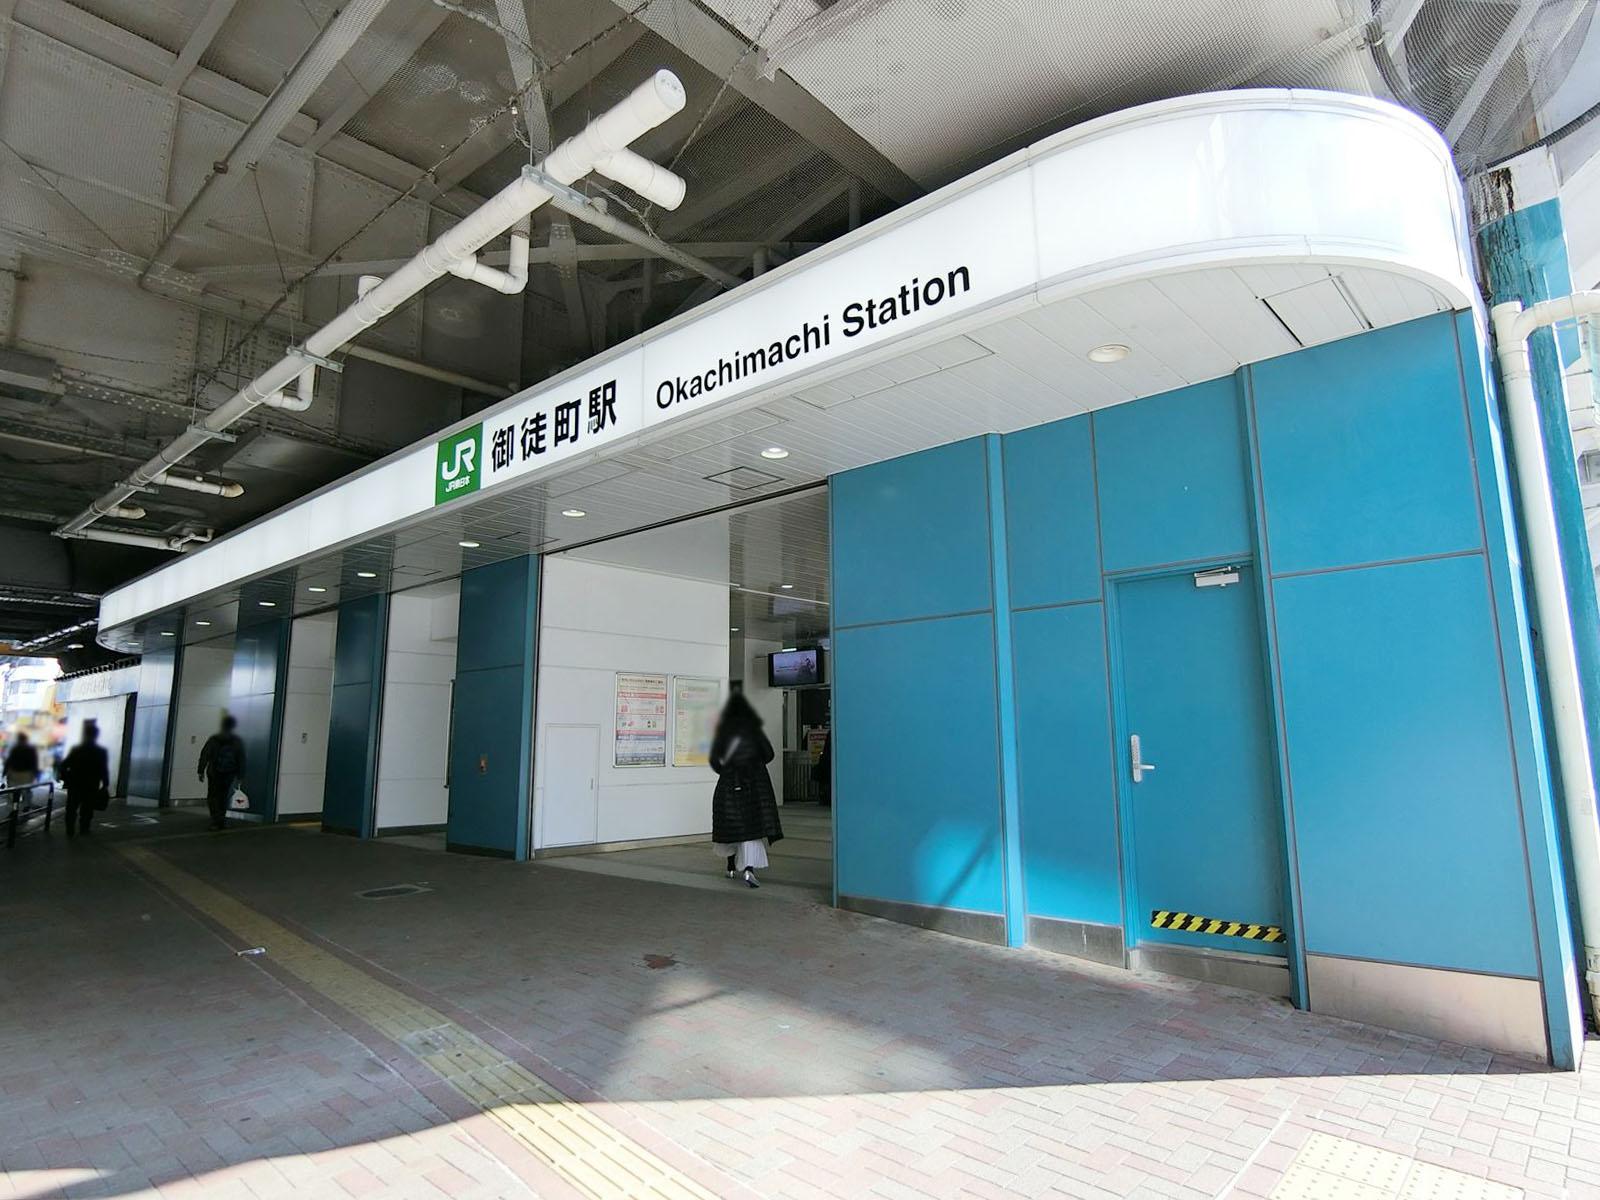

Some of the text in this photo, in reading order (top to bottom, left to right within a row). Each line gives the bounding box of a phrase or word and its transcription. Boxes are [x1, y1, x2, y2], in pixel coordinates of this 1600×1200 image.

[656, 266, 970, 409] Okachimachi Station
[442, 438, 476, 480] JR
[491, 379, 617, 472] 御徒町駅
